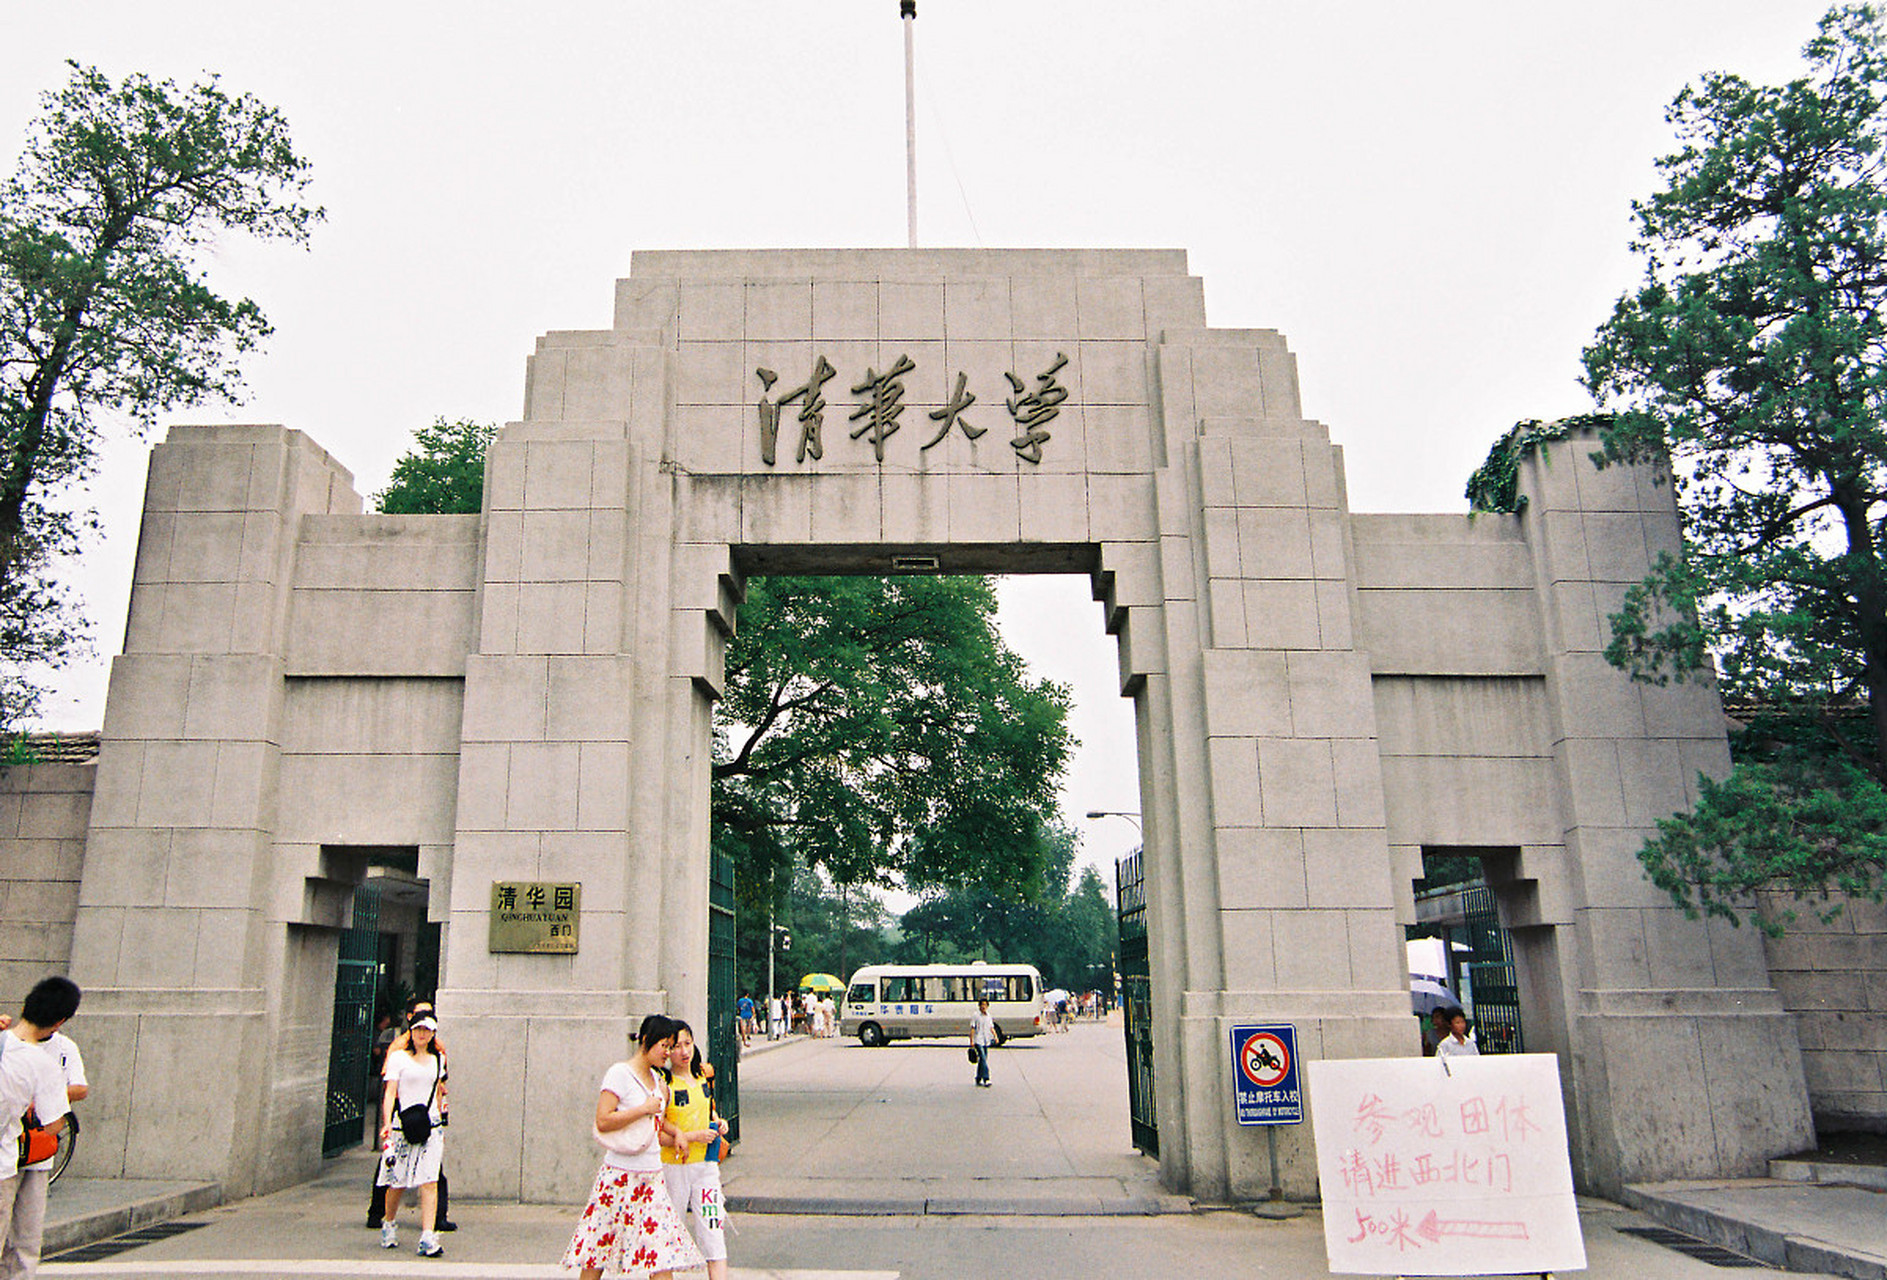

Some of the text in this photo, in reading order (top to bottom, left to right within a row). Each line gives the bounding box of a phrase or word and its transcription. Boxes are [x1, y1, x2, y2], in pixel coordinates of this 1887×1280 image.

[498, 886, 574, 911] 清华园
[550, 924, 572, 937] 西门
[1353, 1094, 1541, 1144] 参观团体
[1340, 1149, 1512, 1197] 请进西北门
[1347, 1207, 1422, 1252] 500米
